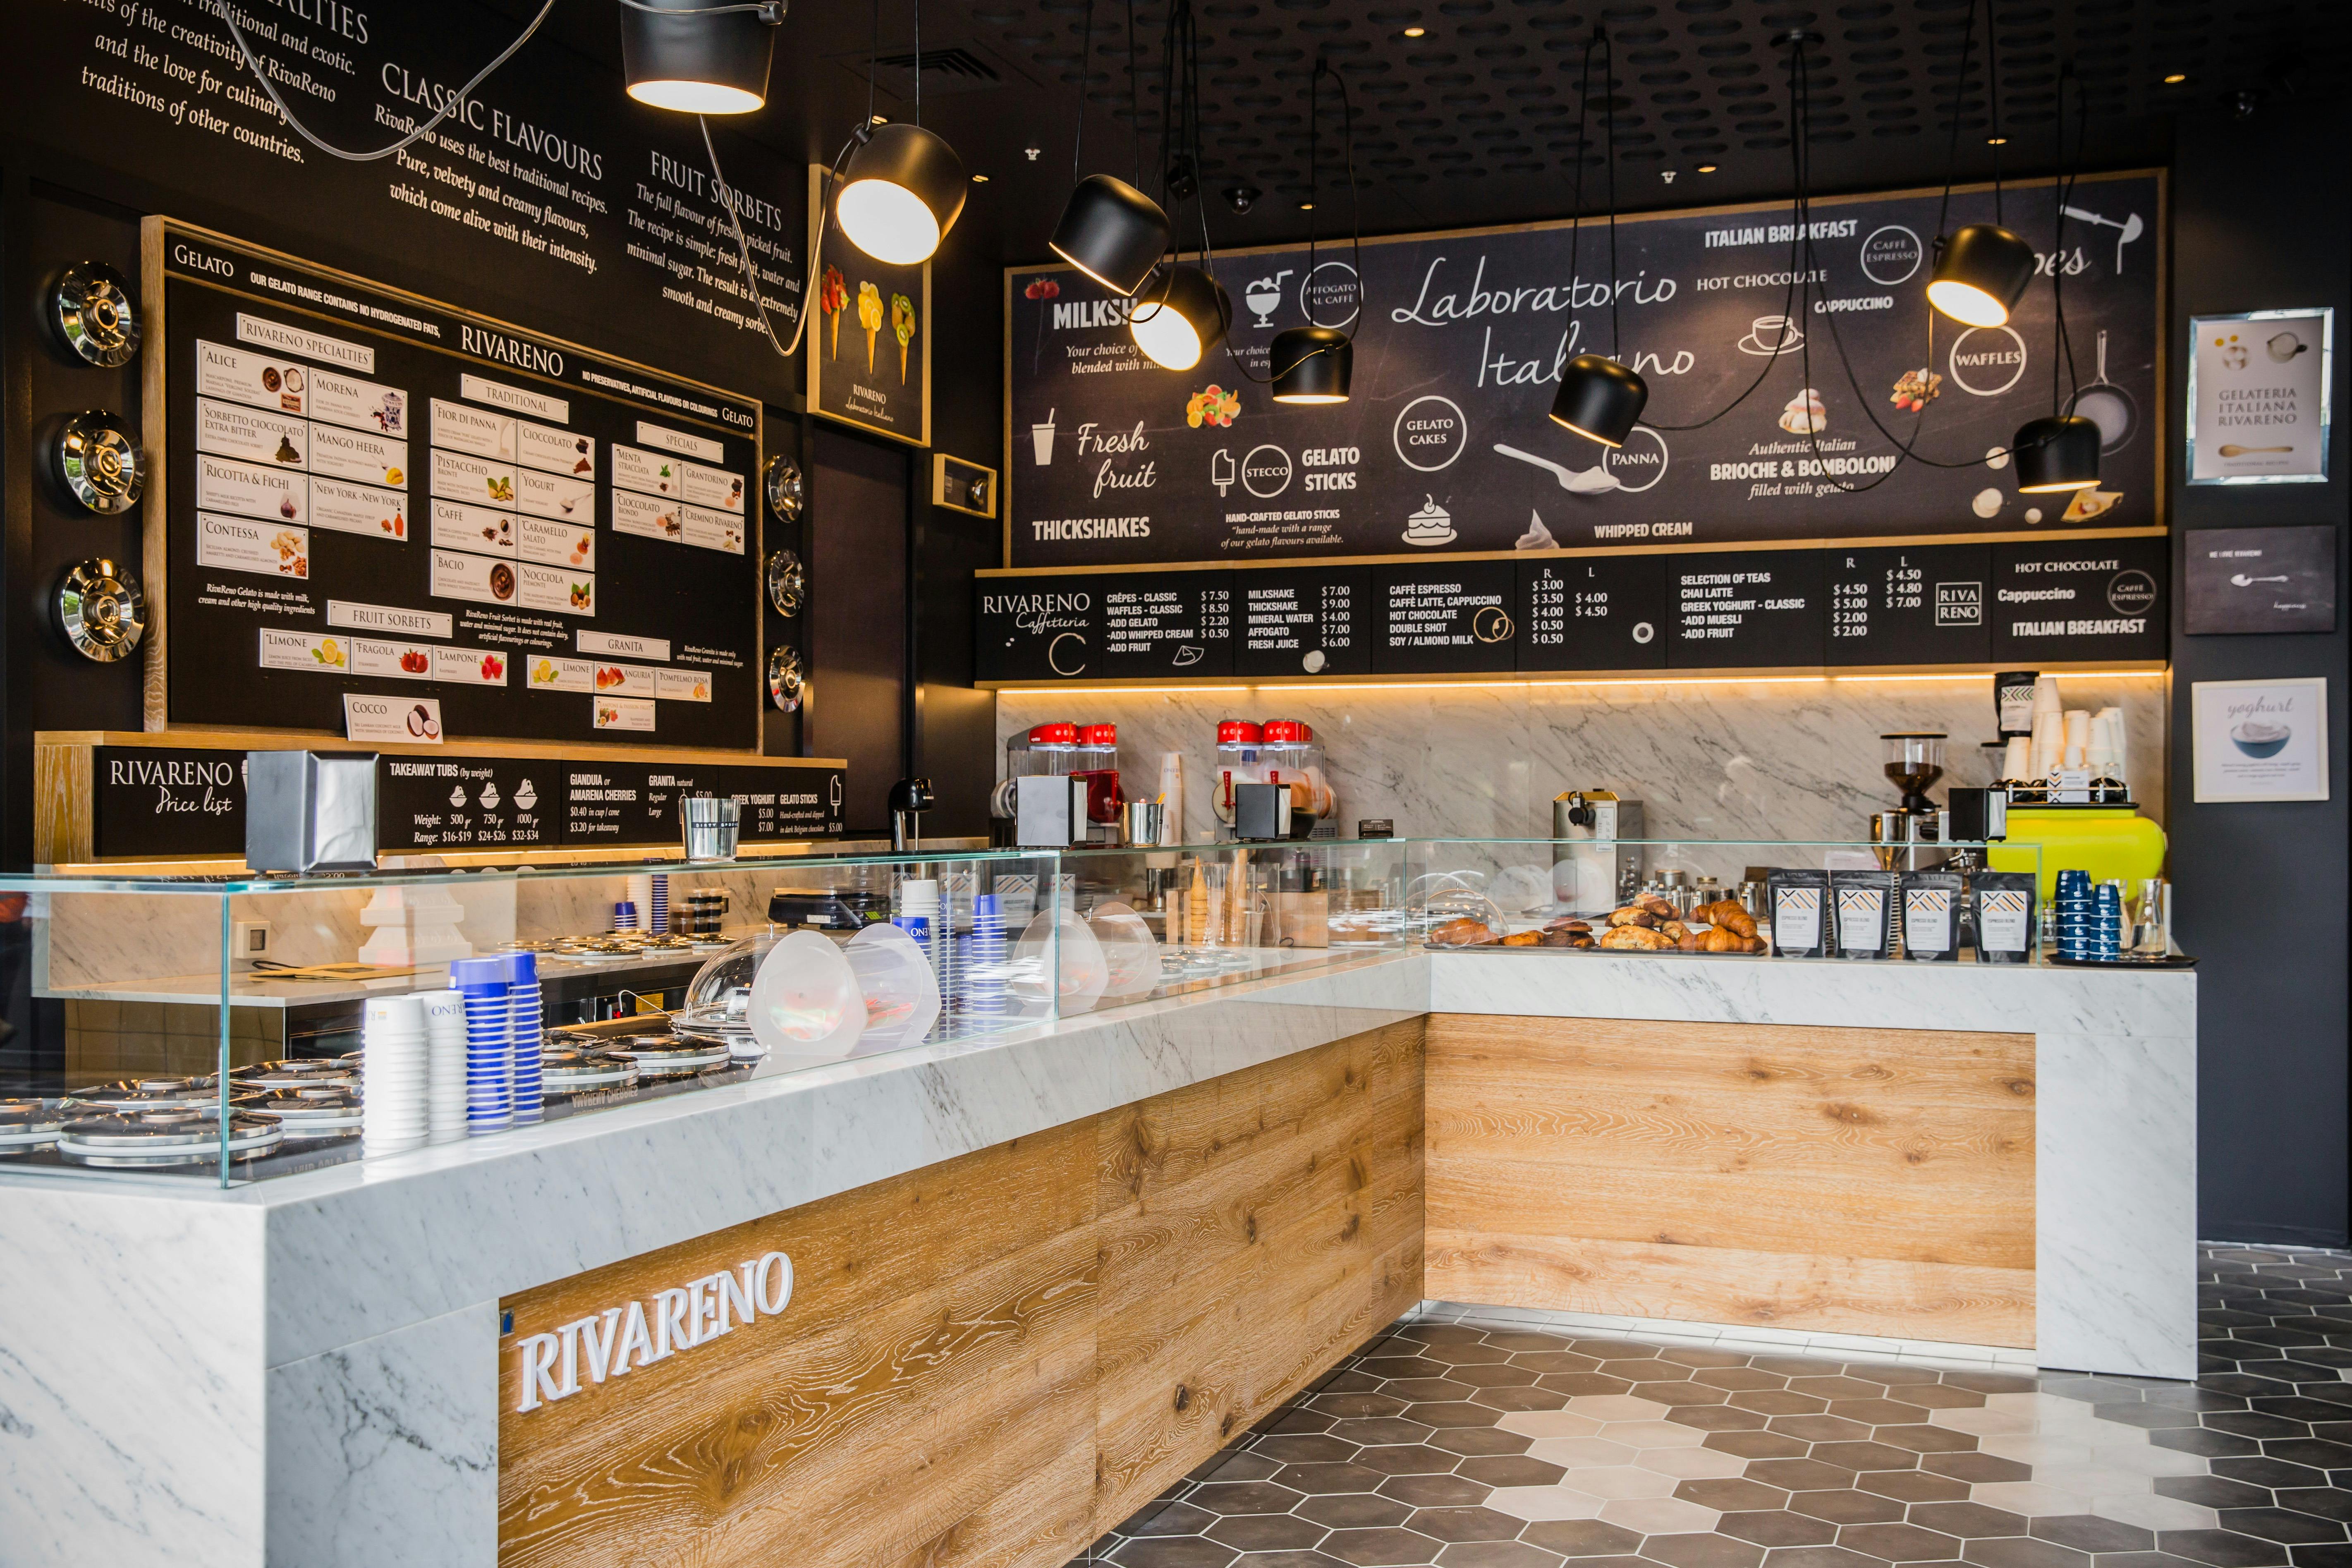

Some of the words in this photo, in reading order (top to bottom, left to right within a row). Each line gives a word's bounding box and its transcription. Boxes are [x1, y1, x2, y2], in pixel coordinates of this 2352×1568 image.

[96, 35, 128, 58] and
[134, 45, 158, 69] the
[164, 54, 196, 84] love
[197, 69, 223, 94] for
[226, 85, 287, 125] culinary
[82, 66, 164, 112] traditions
[170, 101, 187, 125] of
[189, 109, 230, 135] other
[233, 126, 304, 163] countries.
[382, 63, 484, 130] CLASSIC
[493, 110, 603, 181] FLAVOURS
[397, 149, 430, 178] Pure,
[433, 166, 476, 198] velvety
[478, 184, 500, 203] and
[502, 194, 542, 223] creamy
[542, 206, 589, 239] flavours,
[651, 151, 705, 197] FRUIT
[711, 179, 782, 232] SORBETS
[1705, 228, 1765, 248] ITALIAN
[1768, 220, 1857, 243] BREAKFAST
[1392, 256, 1677, 326] Laboratorio
[250, 272, 267, 287] OUR
[268, 277, 297, 295] GELATO
[297, 285, 323, 302] RANGE
[323, 293, 359, 313] CONTAINS
[359, 304, 370, 316] NO
[370, 307, 422, 331] HYDROGENATED
[423, 322, 440, 338] FATS,
[663, 287, 694, 307] smooth
[696, 299, 713, 314] and
[714, 306, 744, 330] creamy
[246, 322, 303, 348] RIVARENO
[306, 339, 368, 365] SPECIALTIES
[462, 325, 563, 376] RIVARENO
[1955, 351, 2021, 366] WAFFLES
[486, 387, 548, 413] TRADITIONAL
[854, 384, 886, 405] RIVARENO
[2219, 388, 2297, 400] GELATERIA
[2219, 401, 2296, 413] ITALIANA
[1407, 419, 1454, 431] GELATO
[2218, 413, 2297, 426] RIVARENO
[666, 435, 697, 451] SPECIALS
[1078, 420, 1149, 456] Fresh
[1409, 433, 1447, 445] CAKES
[1302, 447, 1360, 467] GELATO
[1613, 453, 1660, 465] PANNA
[1247, 467, 1289, 477] STECCO
[1711, 457, 1780, 481] BRIOCHE
[1781, 459, 1795, 477] &
[1798, 456, 1896, 478] BOMBOLONI
[252, 472, 260, 485] &
[1093, 458, 1156, 499] fruit
[1305, 472, 1357, 491] STICKS
[1226, 510, 1282, 523] HAND-CRAFTED
[1283, 510, 1312, 521] GELATO
[1314, 509, 1340, 520] STICKS
[1032, 516, 1150, 541] THICKSHAKES
[1594, 523, 1649, 538] WHIPPED
[1652, 522, 1692, 536] CREAM
[2015, 563, 2041, 573] HOT
[2044, 560, 2120, 572] CHOCOLATE
[206, 583, 237, 595] RivaReno
[237, 587, 257, 597] Gelato
[258, 589, 263, 598] is
[264, 591, 280, 599] made
[281, 592, 294, 601] with
[295, 594, 309, 603] milk,
[1107, 591, 1136, 603] CRÊPES
[1144, 591, 1177, 602] CLASSIC
[1248, 588, 1294, 599] MILKSHAKE
[1390, 583, 1416, 595] CAFFÈ
[1418, 584, 1462, 594] ESPRESSO
[1940, 590, 1977, 602] RIVA
[1998, 589, 2075, 603] Cappuccino
[983, 593, 1090, 614] RIVARENO
[1107, 605, 1142, 615] WAFFLES
[1149, 604, 1182, 615] CLASSIC
[1248, 601, 1298, 612] THICKSHAKE
[1390, 596, 1416, 608] CAFFÈ
[1418, 596, 1445, 607] LATTE,
[1448, 595, 1501, 606] CAPPUCCINO
[1681, 601, 1711, 612] GREEK
[1713, 600, 1756, 611] YOGHURT
[354, 610, 384, 625] FRUIT
[388, 614, 431, 629] SORBETS
[1940, 606, 1979, 620] RENO
[1016, 611, 1090, 634] Caffetteria
[2012, 622, 2064, 637] ITALIAN
[2067, 620, 2146, 634] BREAKFAST
[1248, 626, 1289, 637] AFFOGATO
[608, 639, 643, 652] GRANITA
[2228, 696, 2294, 718] yoghurt
[110, 761, 233, 786] RIVARENO
[390, 763, 435, 776] TAKEAWAY
[437, 764, 458, 777] TUBS
[460, 768, 470, 779] (by
[471, 769, 493, 780] weight)
[570, 773, 603, 785] GIANDUIA
[648, 775, 675, 786] GRANITA
[156, 785, 199, 814] Price
[203, 786, 232, 816] list
[570, 790, 603, 801] AMARENA
[605, 790, 636, 801] CHERRIES
[780, 794, 799, 804] GELATO
[800, 794, 818, 804] STICKS
[414, 814, 441, 828] Weight:
[450, 814, 464, 824] 500
[483, 814, 497, 824] 750
[517, 814, 532, 823] 1000
[758, 808, 774, 819] $5.00
[414, 832, 438, 845] Range:
[443, 831, 471, 842] $16-$19
[478, 830, 506, 841] $24-$26
[512, 829, 539, 840] $32-$34
[517, 1251, 794, 1412] RIVARENO
